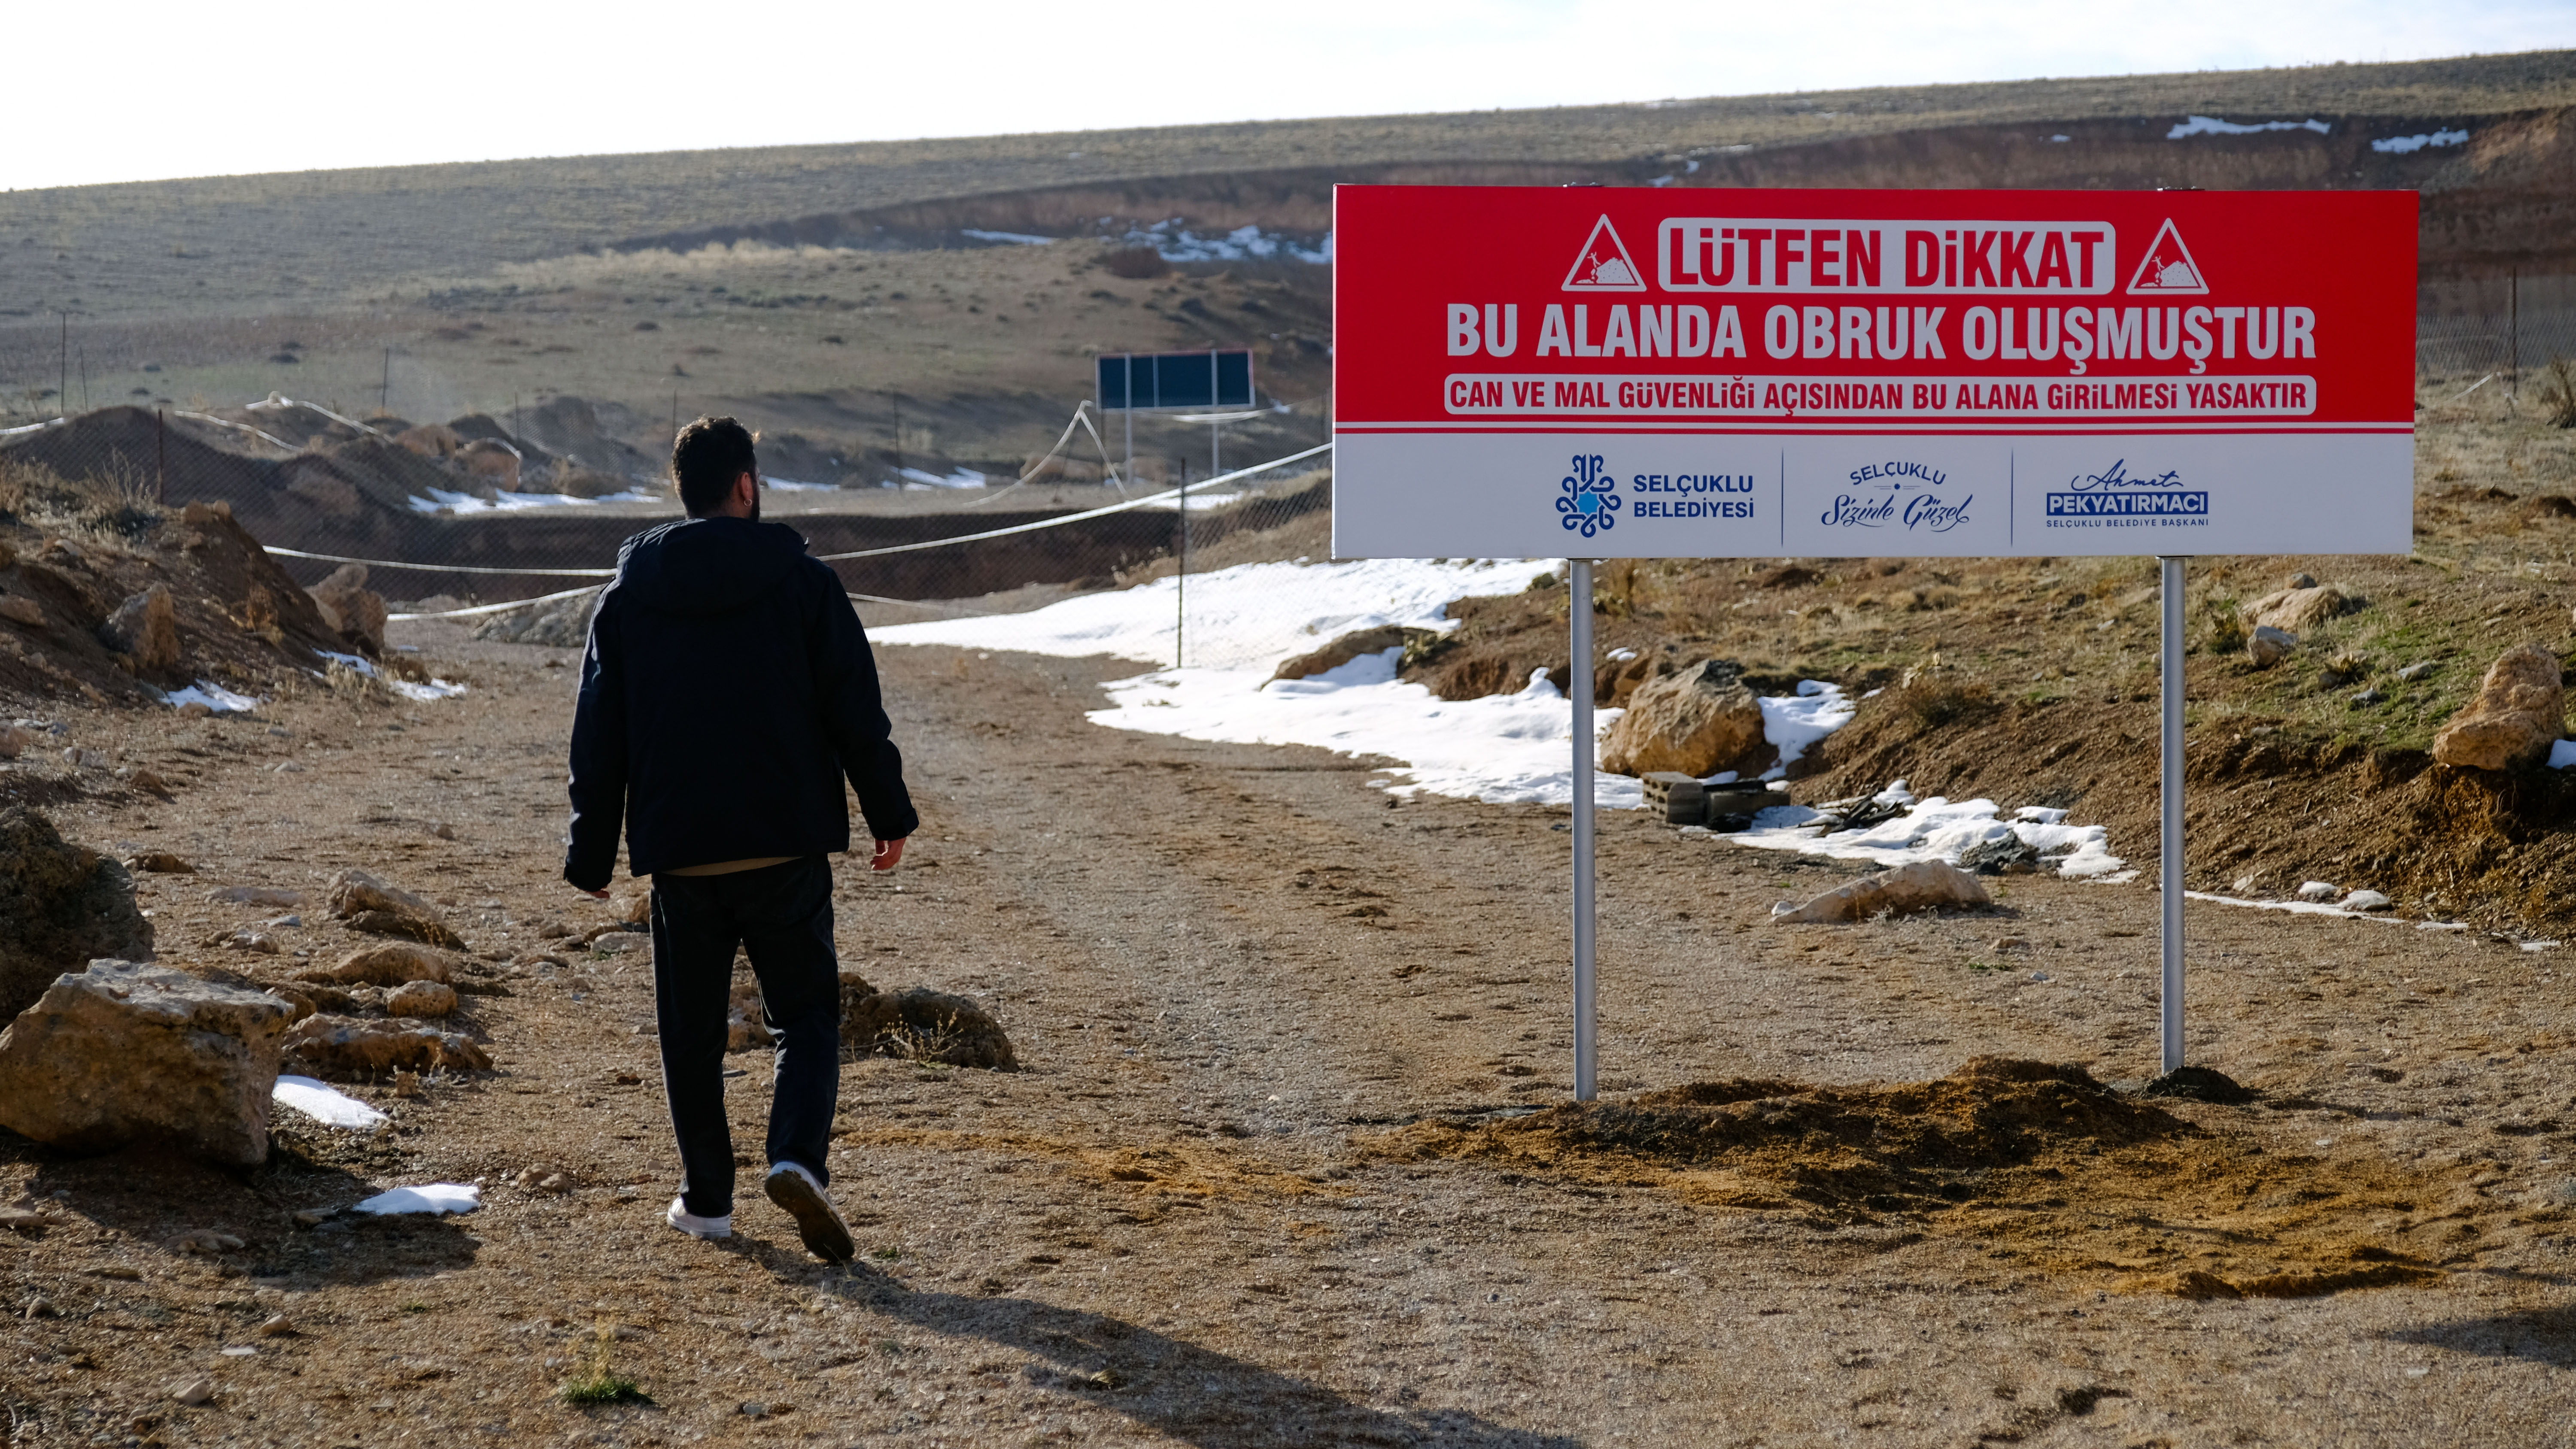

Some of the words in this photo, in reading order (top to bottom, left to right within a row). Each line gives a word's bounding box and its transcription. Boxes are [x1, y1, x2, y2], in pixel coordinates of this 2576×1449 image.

[1670, 227, 1881, 287] LÜTFEN
[1448, 303, 1517, 357] BU
[1536, 304, 1747, 358] ALANDA
[1765, 305, 1946, 360] OBRUK
[1963, 306, 2316, 374] OLUŞMUŞTUR
[1450, 381, 1503, 407] CAN
[1513, 382, 1545, 407] VE
[1555, 382, 1610, 408] MAL
[1764, 383, 1902, 416] AÇISINDAN
[1914, 384, 1947, 409] BU
[1956, 384, 2038, 409] ALANA
[2187, 383, 2306, 409] YASAKTIR
[1633, 474, 1753, 496] SELÇUKLU
[1850, 461, 1946, 485] SELÇUKLU
[2071, 458, 2184, 491] Ahmet
[1634, 497, 1754, 518] BELEDİYESİ
[1821, 494, 1894, 527] Sizinle
[1903, 494, 1973, 532] Güzel
[2050, 494, 2205, 513] PEKYATIRMACI
[2047, 520, 2101, 528] SELÇUKLU
[2162, 518, 2208, 527] BAŞKANI
